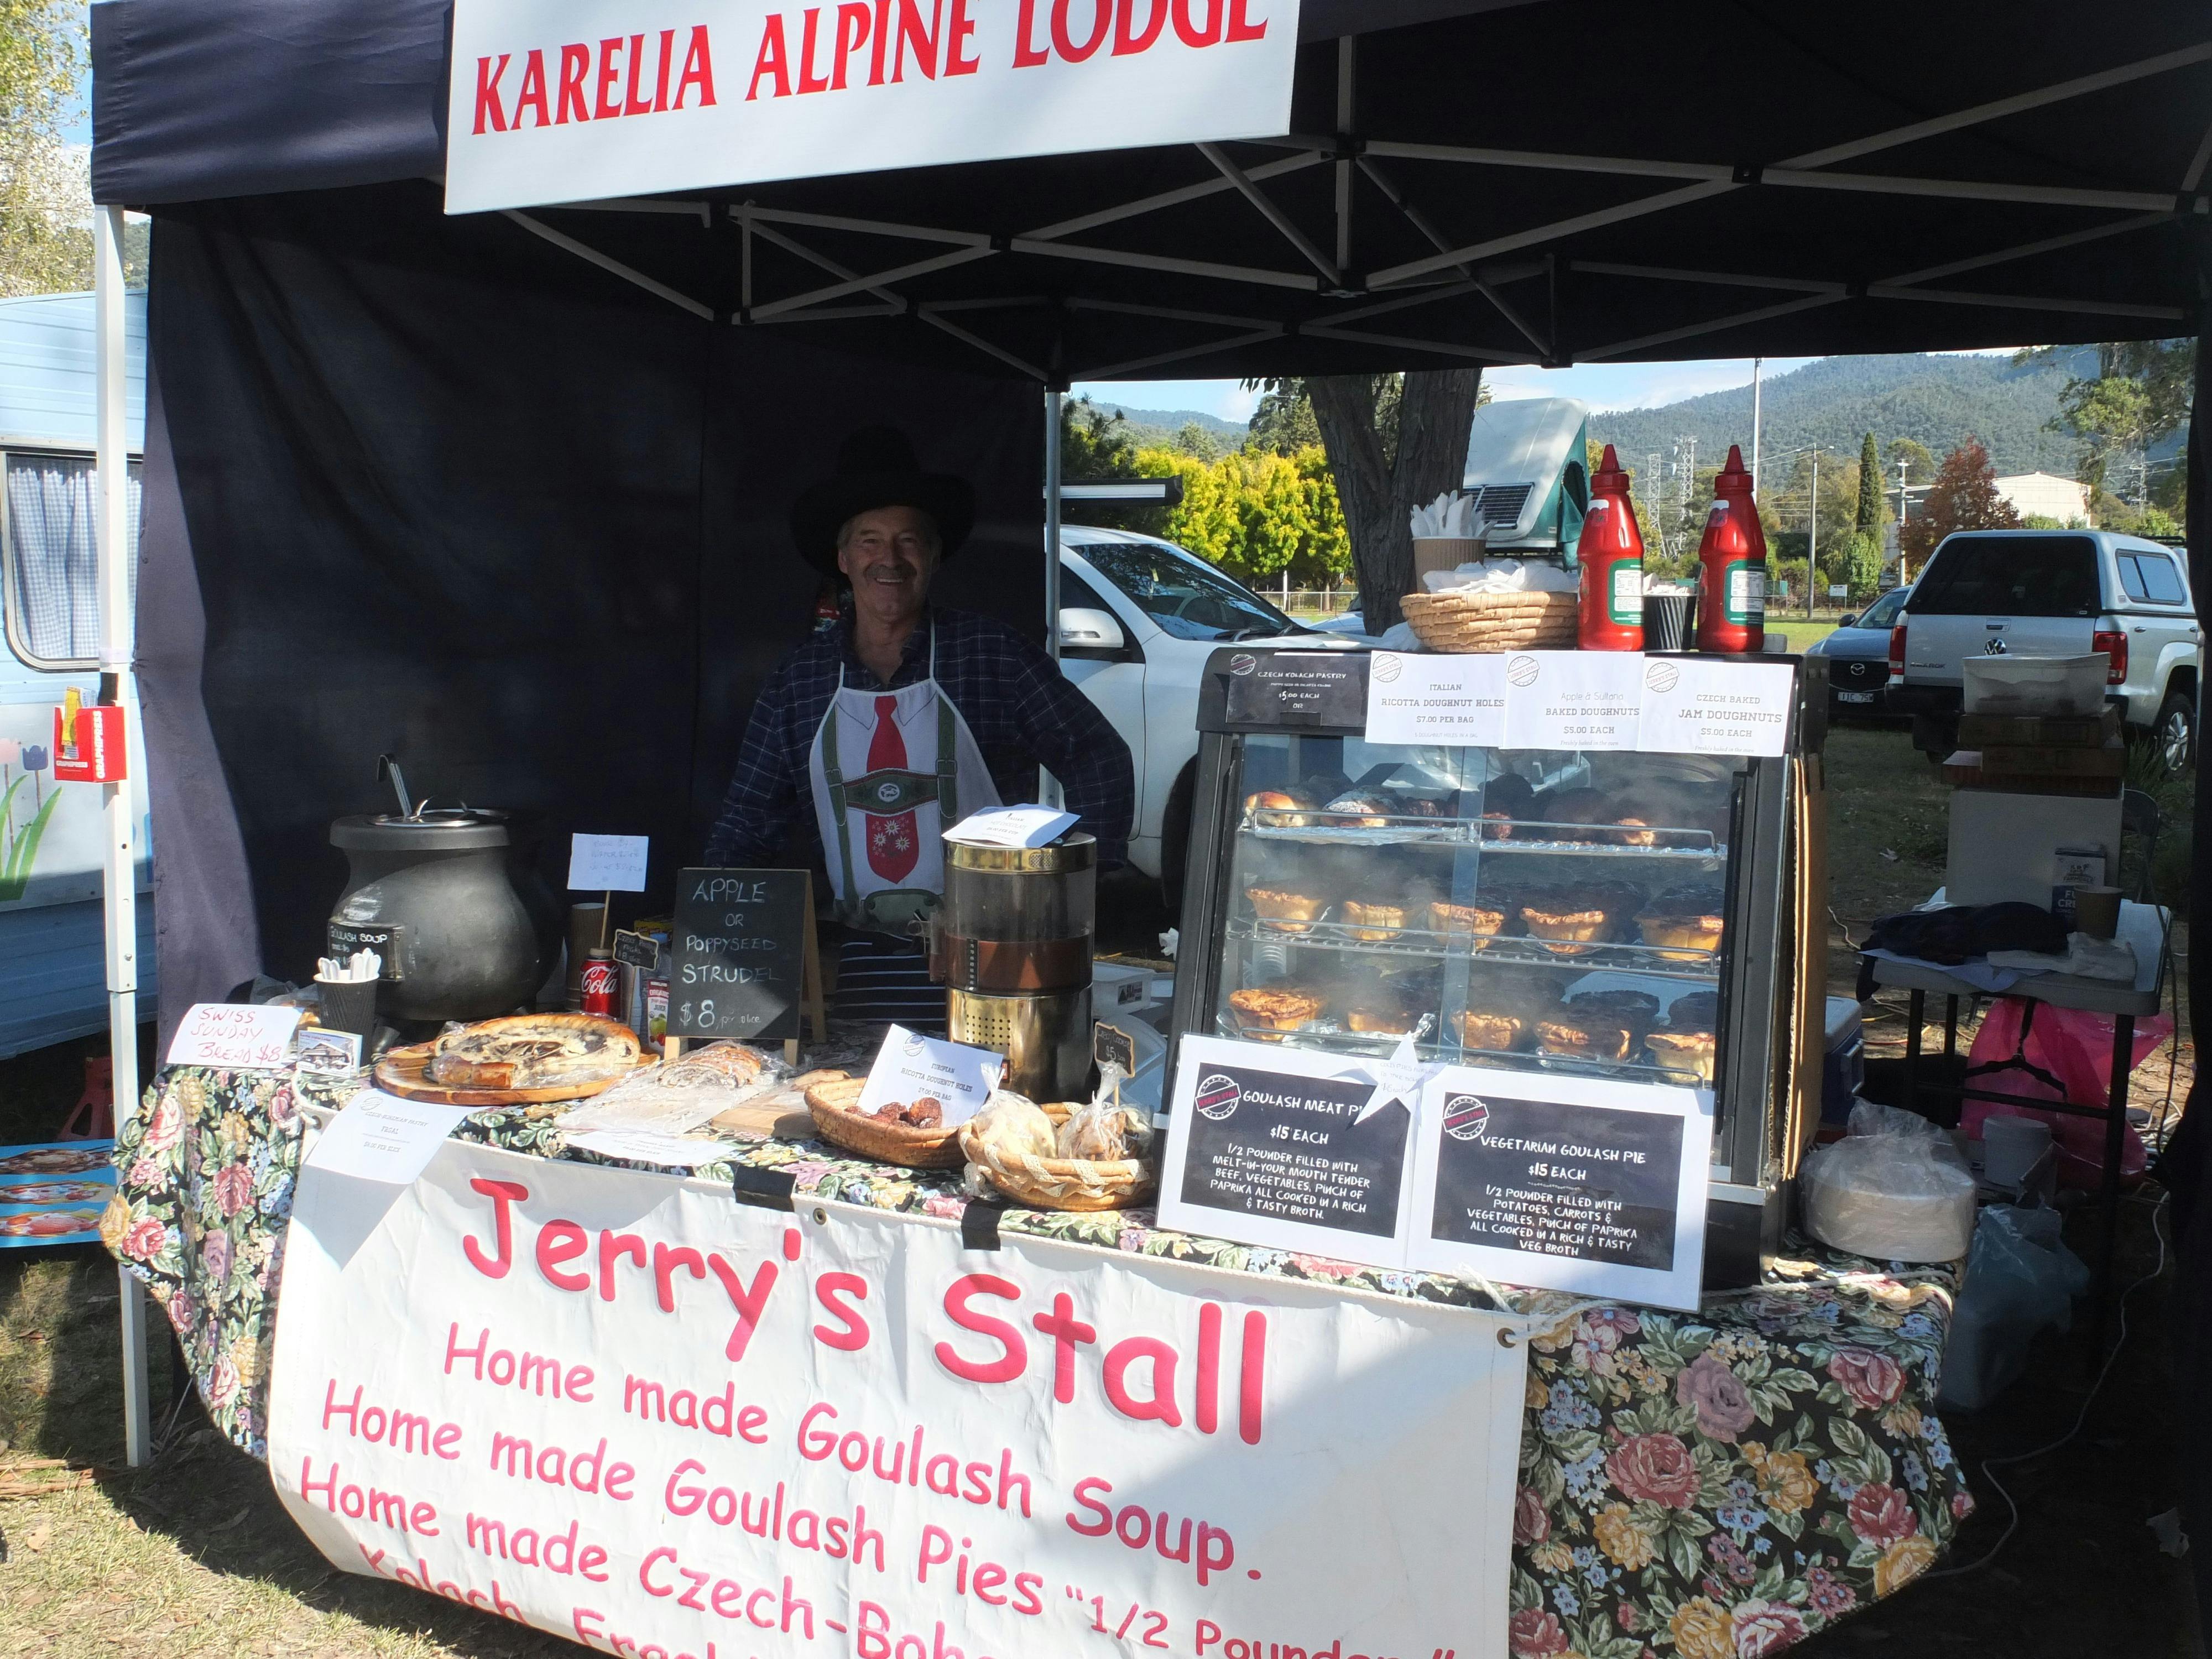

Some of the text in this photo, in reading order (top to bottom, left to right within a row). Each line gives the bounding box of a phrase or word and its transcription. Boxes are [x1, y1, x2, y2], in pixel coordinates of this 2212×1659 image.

[472, 24, 717, 135] KARELIA
[745, 0, 980, 101] ALPINE
[1381, 698, 1420, 707] RICOTTA
[1561, 692, 1583, 702] Apple
[1594, 692, 1624, 701] Sultana
[1729, 696, 1761, 704] BAKED
[1678, 709, 1782, 723] JAM DOUGHNUTS
[692, 878, 766, 903] APPLE
[725, 914, 743, 927] OR
[359, 933, 387, 943] SOUP
[686, 935, 777, 953] POPPYSEED
[682, 963, 785, 984] STRUDEL
[199, 1007, 255, 1023] SWISS
[191, 1023, 264, 1042] SUNDAY
[197, 1042, 282, 1066] BREAD $8
[901, 1068, 925, 1080] RICOTTA
[956, 1083, 973, 1093] HOLES
[1243, 1090, 1301, 1108] GOULASH
[1305, 1099, 1344, 1114] MEAT
[1270, 1124, 1329, 1144] $15 EACH
[1228, 1143, 1358, 1173] 1/2 POUNDER FILLED WITH
[1480, 1135, 1646, 1164] VEGETARIAN GOULASH PIE
[1213, 1155, 1370, 1188] MELT-IN-YOUR MOUTH TENDER
[1528, 1162, 1587, 1181] $15 EACH
[1210, 1179, 1367, 1213] PAPRIKA ALL COOKED IN A RICH
[1315, 1183, 1347, 1197] PINCH
[1350, 1190, 1364, 1199] OF
[1486, 1184, 1622, 1211] 1/2 POUNDER FILLED WITH
[1246, 1197, 1324, 1219] & TASTY BROTH.
[1554, 1207, 1601, 1222] CARROTS
[1605, 1212, 1611, 1224] &
[1470, 1221, 1632, 1252] ALL COOKED IN A RICH & TASTY
[1539, 1217, 1571, 1230] PINCH
[1574, 1223, 1588, 1232] OF
[1592, 1224, 1637, 1239] PAPRIKA
[1519, 1239, 1579, 1256] VEG BROTH
[463, 1178, 1267, 1445] Jerry's Stall
[444, 1322, 1261, 1587] Home made Goulash Soup.
[322, 1379, 462, 1460] Home
[491, 1438, 635, 1500] made
[665, 1459, 885, 1572] Goulash
[917, 1525, 1043, 1615] Pies
[301, 1455, 440, 1536] Home
[466, 1512, 608, 1582] made
[639, 1547, 996, 1659] Czech-Boh
